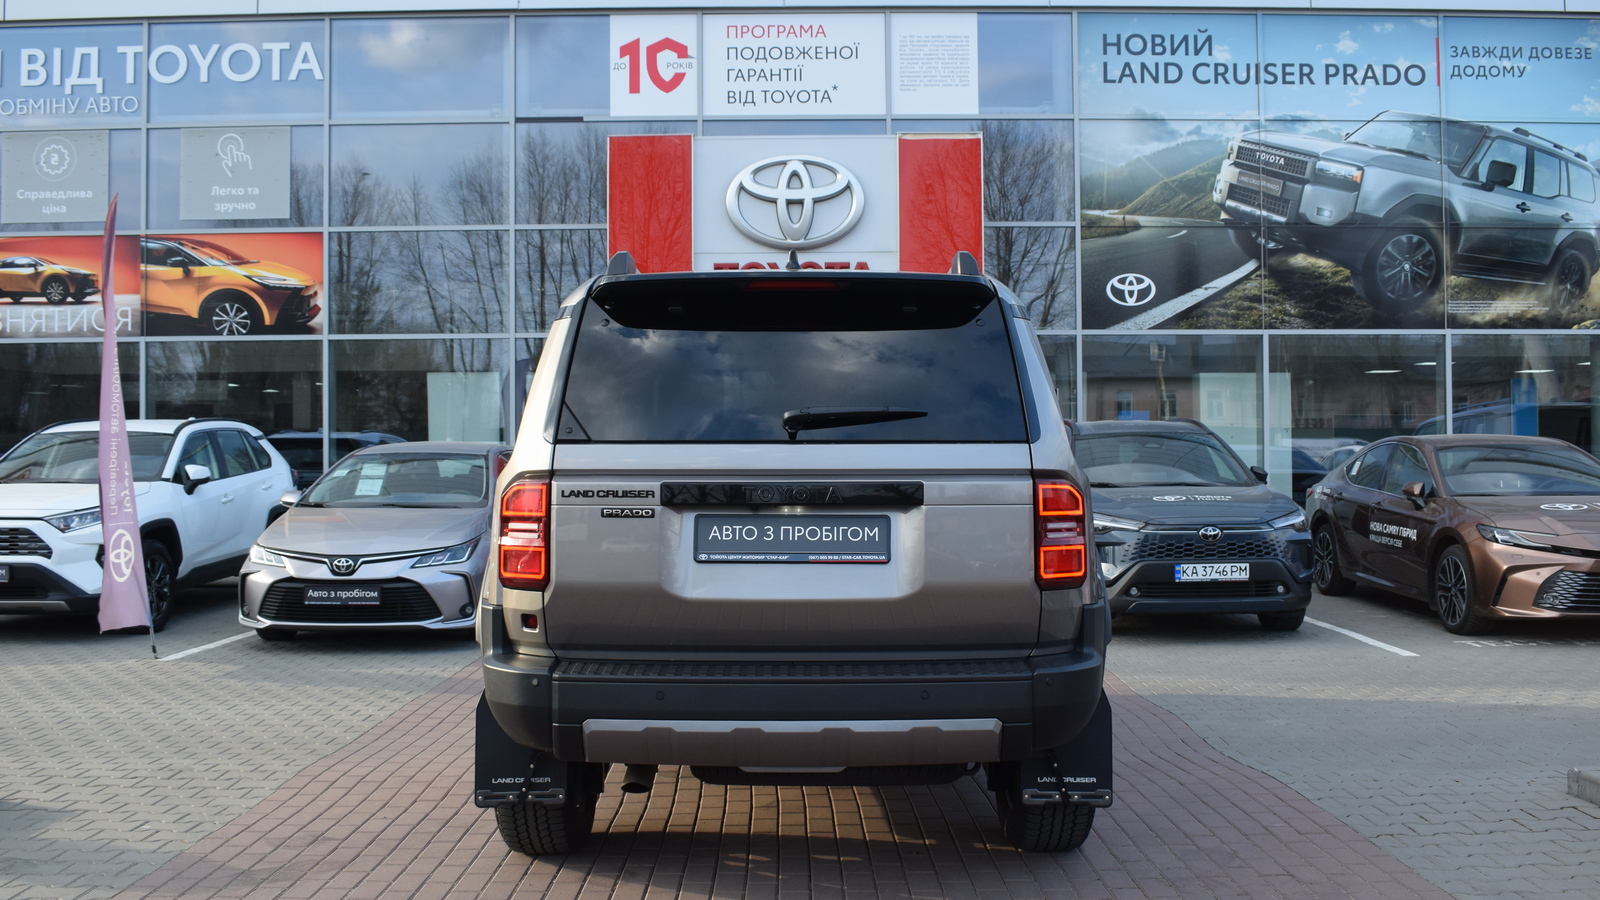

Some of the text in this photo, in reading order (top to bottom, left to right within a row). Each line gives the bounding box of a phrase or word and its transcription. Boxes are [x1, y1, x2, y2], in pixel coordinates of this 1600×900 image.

[726, 24, 827, 39] ПРОГРАМА
[1101, 29, 1214, 57] НОВИЙ
[726, 42, 860, 62] ПОДОВЖЕНОЇ
[1450, 45, 1593, 62] ЗАВЖДИ ДОВЕЗЕ
[20, 47, 104, 95] ВІД
[117, 41, 324, 85] TOYOTA
[613, 62, 627, 72] ДО
[666, 61, 694, 70] РОКІВ
[726, 64, 803, 83] ГАРАНТІЇ
[1101, 61, 1427, 87] LAND CRUISER PRADO
[1450, 65, 1527, 80] ДОДОМУ
[0, 95, 139, 116] ОБМІНУ АВТО
[726, 89, 756, 107] ВІД
[1255, 152, 1285, 165] TOYOTA
[17, 188, 93, 201] Справедлива
[211, 186, 259, 197] Легко та
[42, 203, 67, 215] ціна
[214, 201, 256, 213] зручно
[0, 306, 132, 333] НЯТИСЯ
[561, 489, 655, 498] LAND CRUISER
[742, 486, 844, 503] TOYOTA
[603, 509, 652, 517] PRADO
[708, 525, 879, 542] АВТО З ПРОБІГОМ
[1182, 565, 1248, 577] KA 3746 PM
[307, 589, 328, 597] Авто
[337, 589, 378, 599] пробігом
